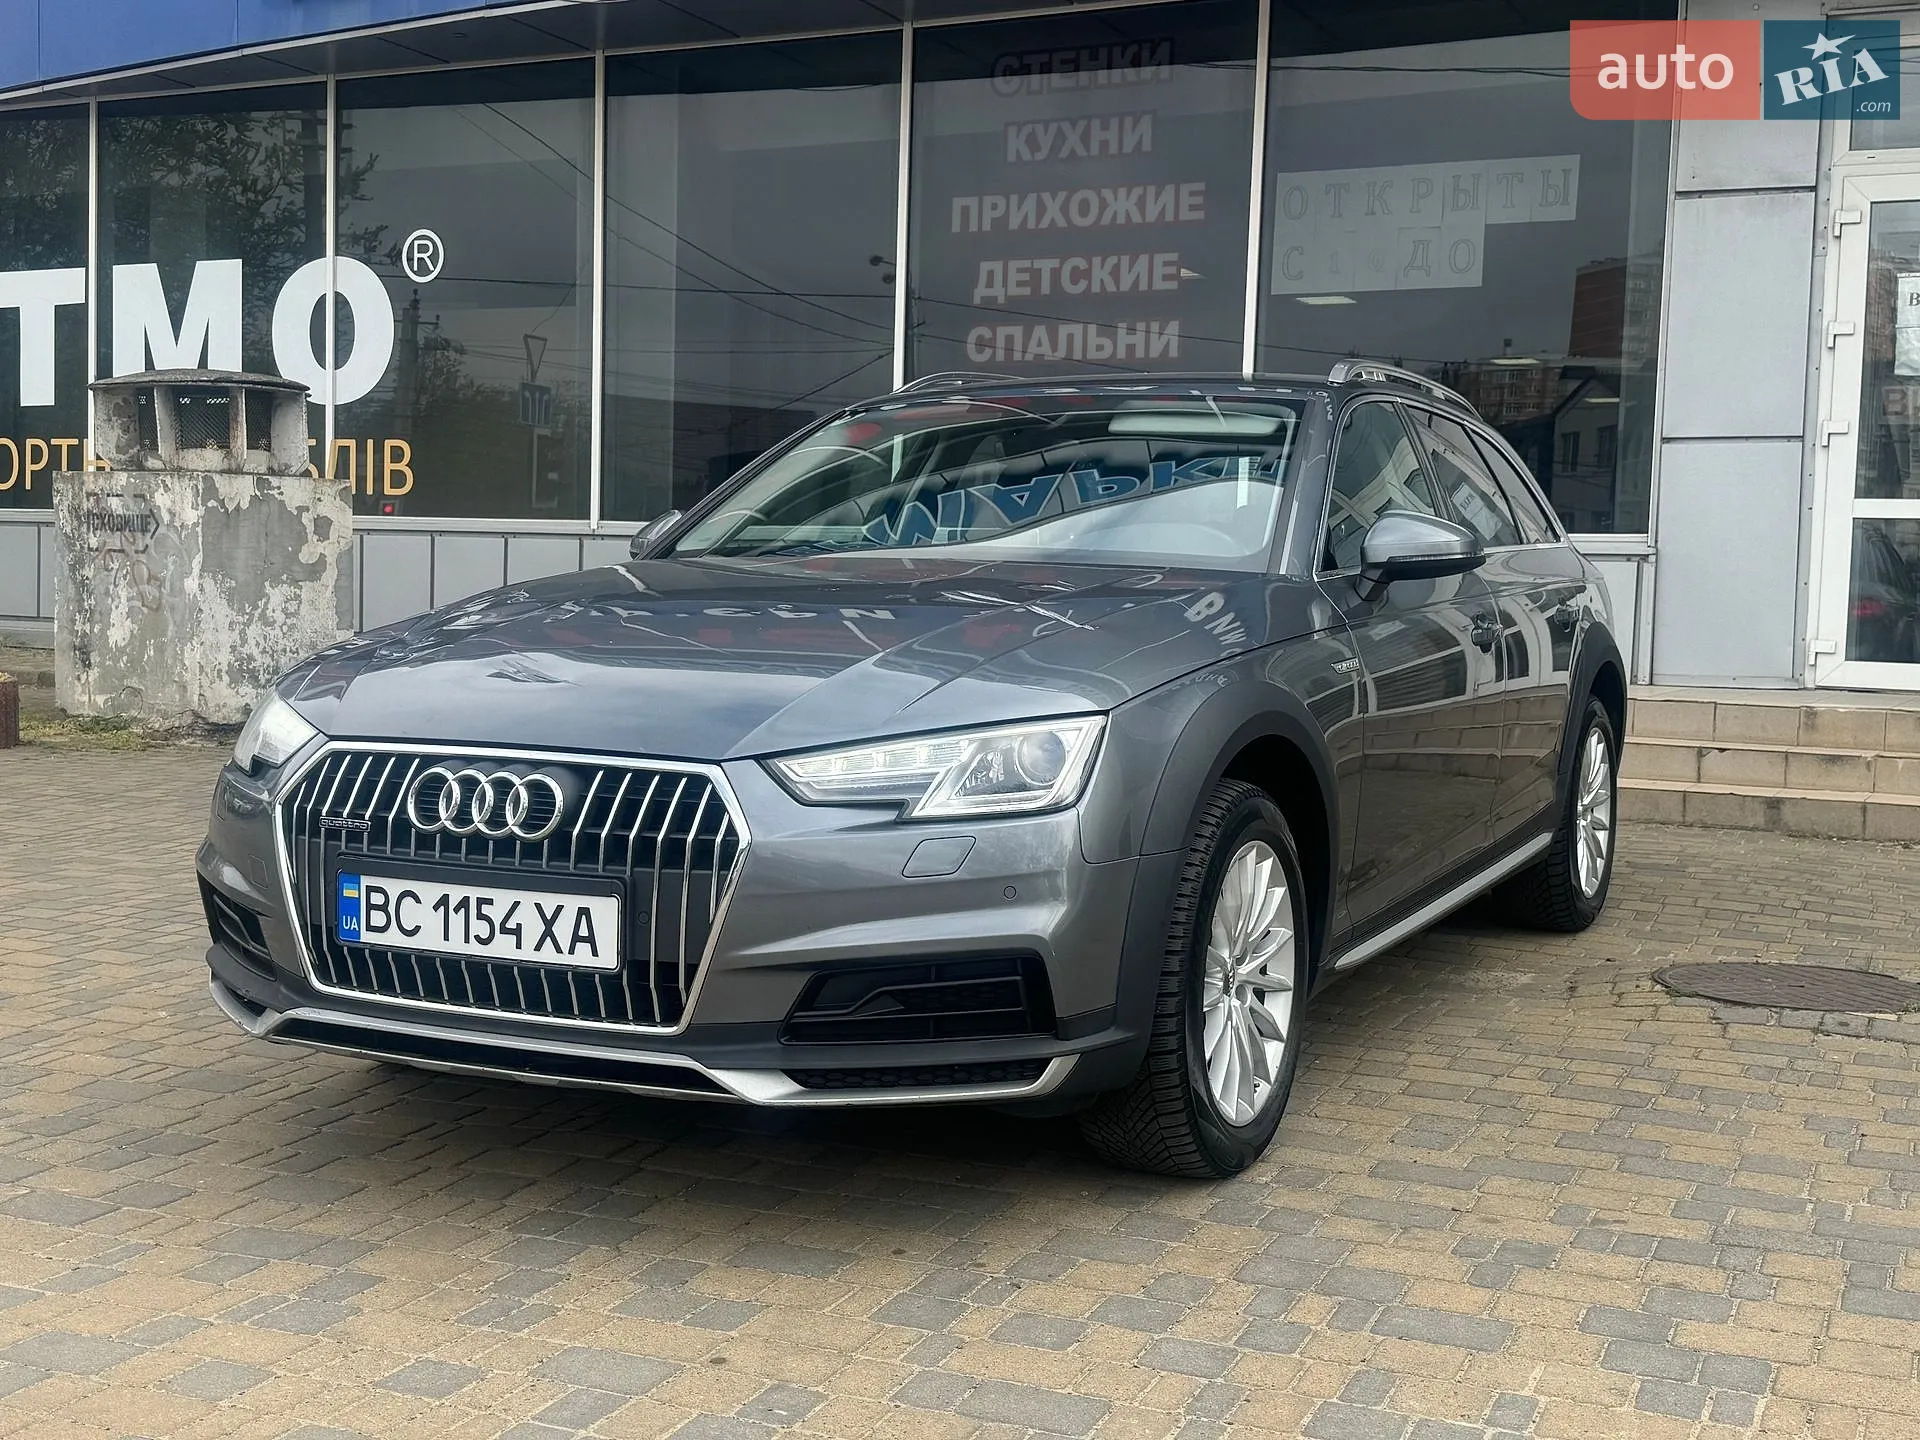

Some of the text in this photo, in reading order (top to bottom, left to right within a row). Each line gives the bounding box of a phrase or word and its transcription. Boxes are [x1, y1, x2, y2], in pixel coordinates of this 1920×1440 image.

[992, 38, 1174, 96] СТЕНКИ
[1005, 112, 1154, 164] КУХНИ
[950, 182, 1207, 234] ПРИХОЖИЕ
[1282, 167, 1573, 221] ОТКРЫТЫ
[972, 252, 1179, 305] ДЕТСКИЕ
[1402, 237, 1476, 280] ДО
[966, 320, 1181, 363] СПАЛЬНИ
[320, 818, 368, 830] quattro
[342, 914, 359, 932] UA
